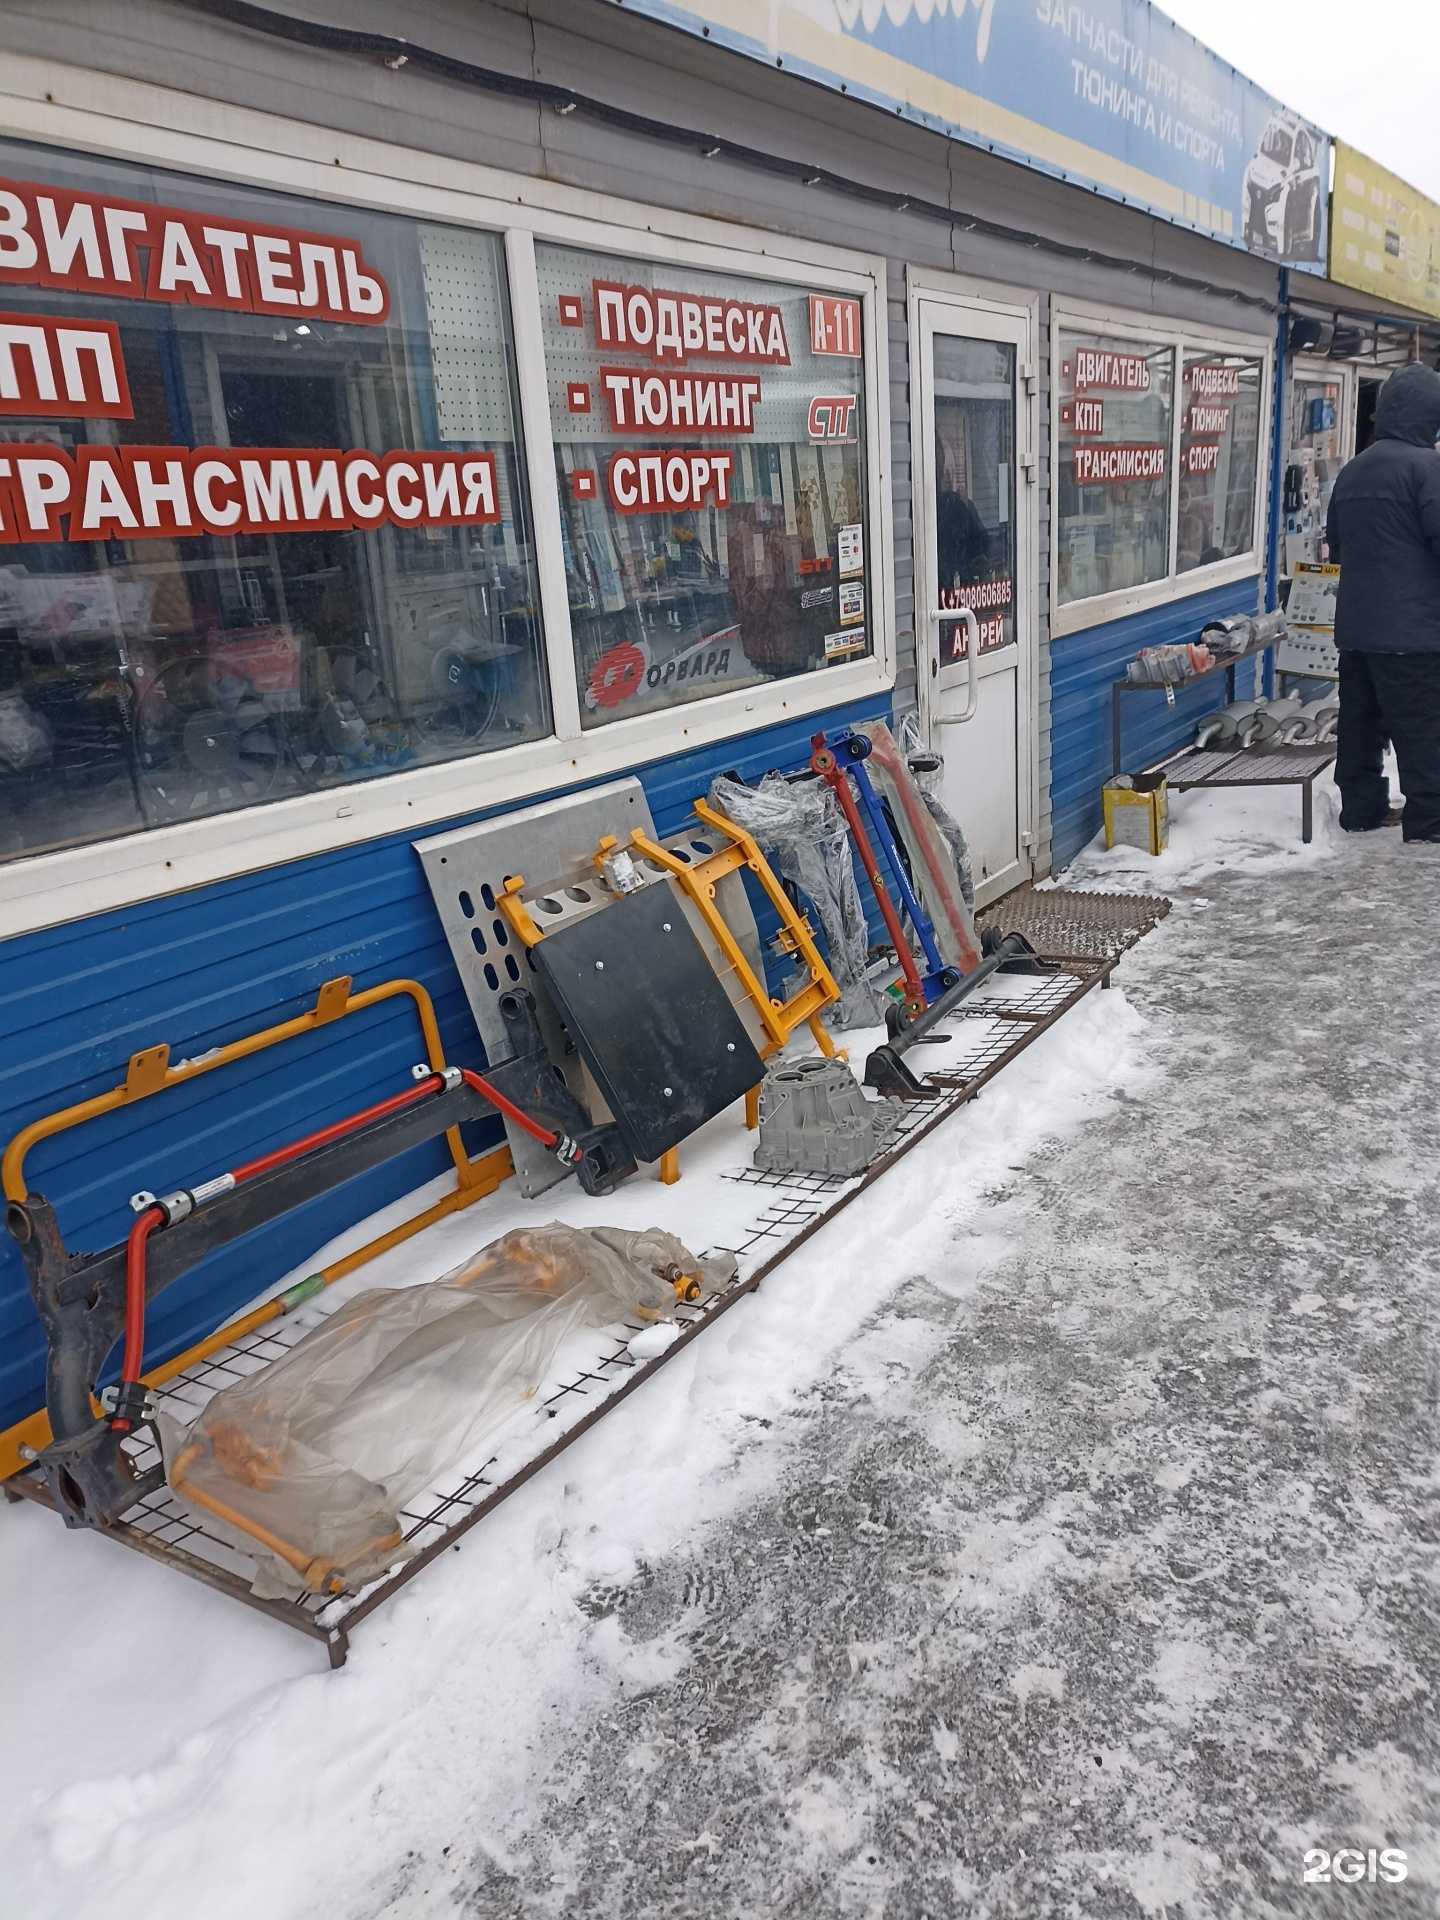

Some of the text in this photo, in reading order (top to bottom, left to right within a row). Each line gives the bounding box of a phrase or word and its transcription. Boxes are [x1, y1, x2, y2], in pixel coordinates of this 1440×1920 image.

[1071, 59, 1225, 173] ТЮНИНГА И СПОРТА
[598, 289, 787, 358] ПОДВЕСКА
[1075, 352, 1150, 388] ДВИГАТЕЛЬ
[1191, 366, 1239, 395] ПОДВЕСКА
[605, 374, 758, 427] ТЮНИНГ
[1075, 402, 1103, 432] КПП
[1191, 406, 1230, 432] ТЮНИНГ
[1075, 448, 1165, 479] ТРАНСМИССИЯ
[1188, 446, 1220, 471] СПОРТ
[613, 456, 731, 507] СПОРТ
[953, 615, 1004, 655] АНРЕЙ
